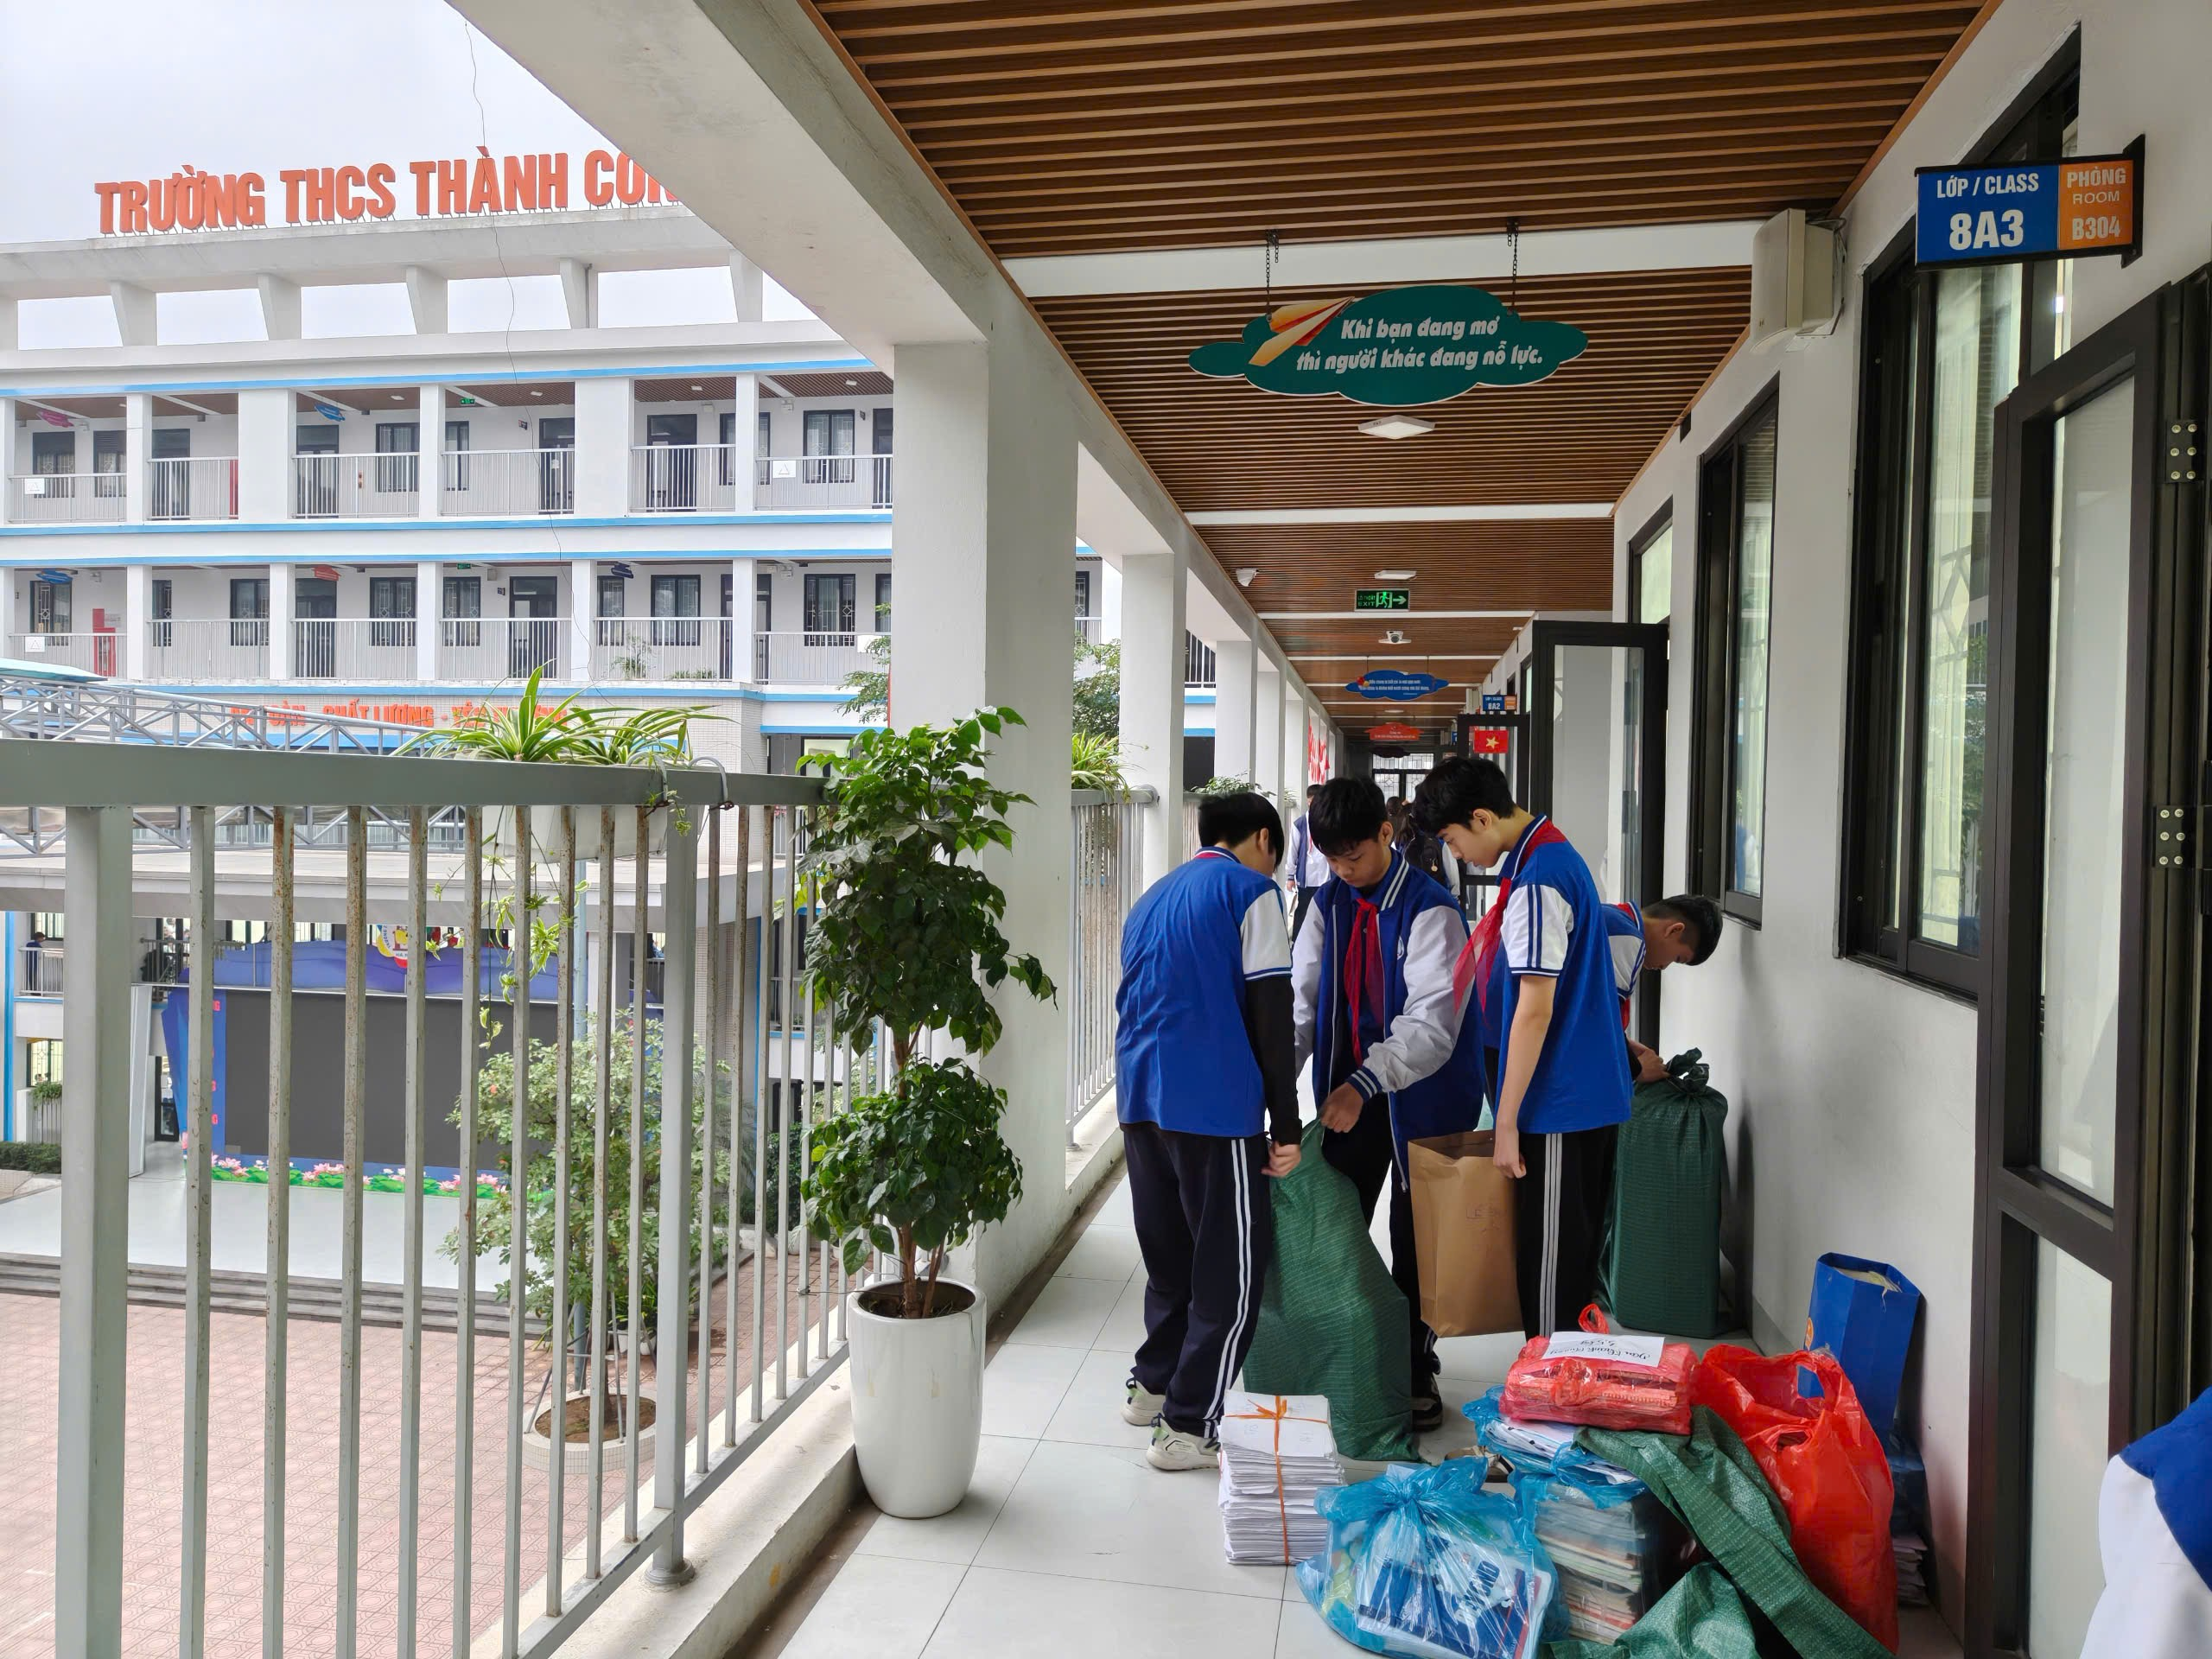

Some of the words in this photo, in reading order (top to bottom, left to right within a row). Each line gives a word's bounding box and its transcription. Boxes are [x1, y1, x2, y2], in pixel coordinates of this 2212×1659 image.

[94, 164, 265, 235] TRƯỜNG
[279, 163, 397, 225] THCS
[410, 145, 569, 217] THÀNH
[1936, 175, 1968, 198] LỚP
[1973, 176, 1980, 196] /
[1984, 173, 2039, 195] CLASS
[2067, 166, 2126, 188] PHÒNG
[2073, 191, 2120, 205] ROOM
[1949, 209, 2024, 251] 8A3
[2072, 215, 2120, 240] B304
[1341, 318, 1372, 340] Khi
[1376, 318, 1412, 345] bạn
[1417, 316, 1465, 341] đang
[1470, 316, 1501, 335] mơ
[1296, 350, 1321, 372] thì
[1325, 347, 1378, 374] người
[1381, 346, 1425, 369] khác
[1430, 347, 1478, 370] đang
[1483, 340, 1508, 365] nỗ
[1510, 346, 1543, 370] lực.
